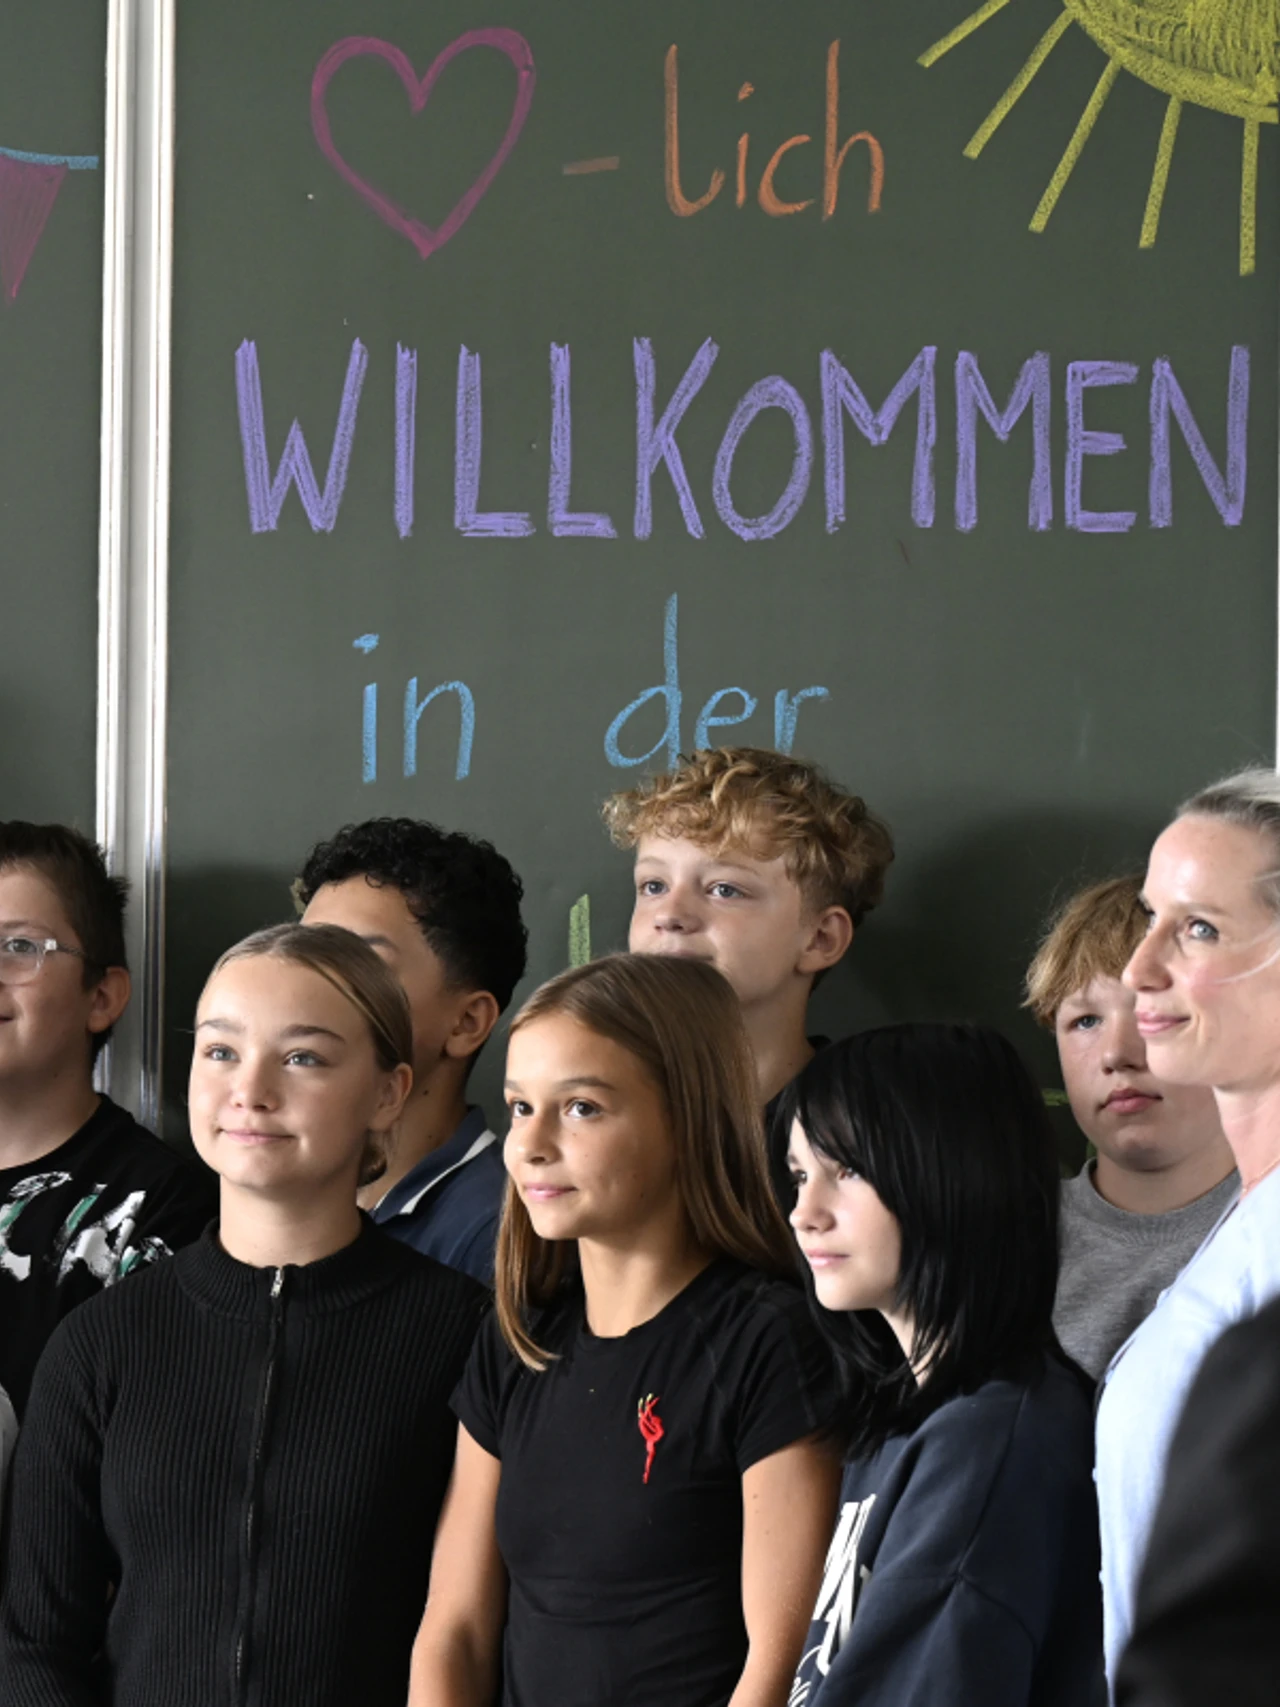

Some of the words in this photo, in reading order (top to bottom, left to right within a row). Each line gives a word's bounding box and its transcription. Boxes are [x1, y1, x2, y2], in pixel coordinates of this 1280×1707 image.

[234, 337, 1252, 542] WILLKOMMEN
[353, 633, 476, 784] in
[603, 591, 831, 770] der
